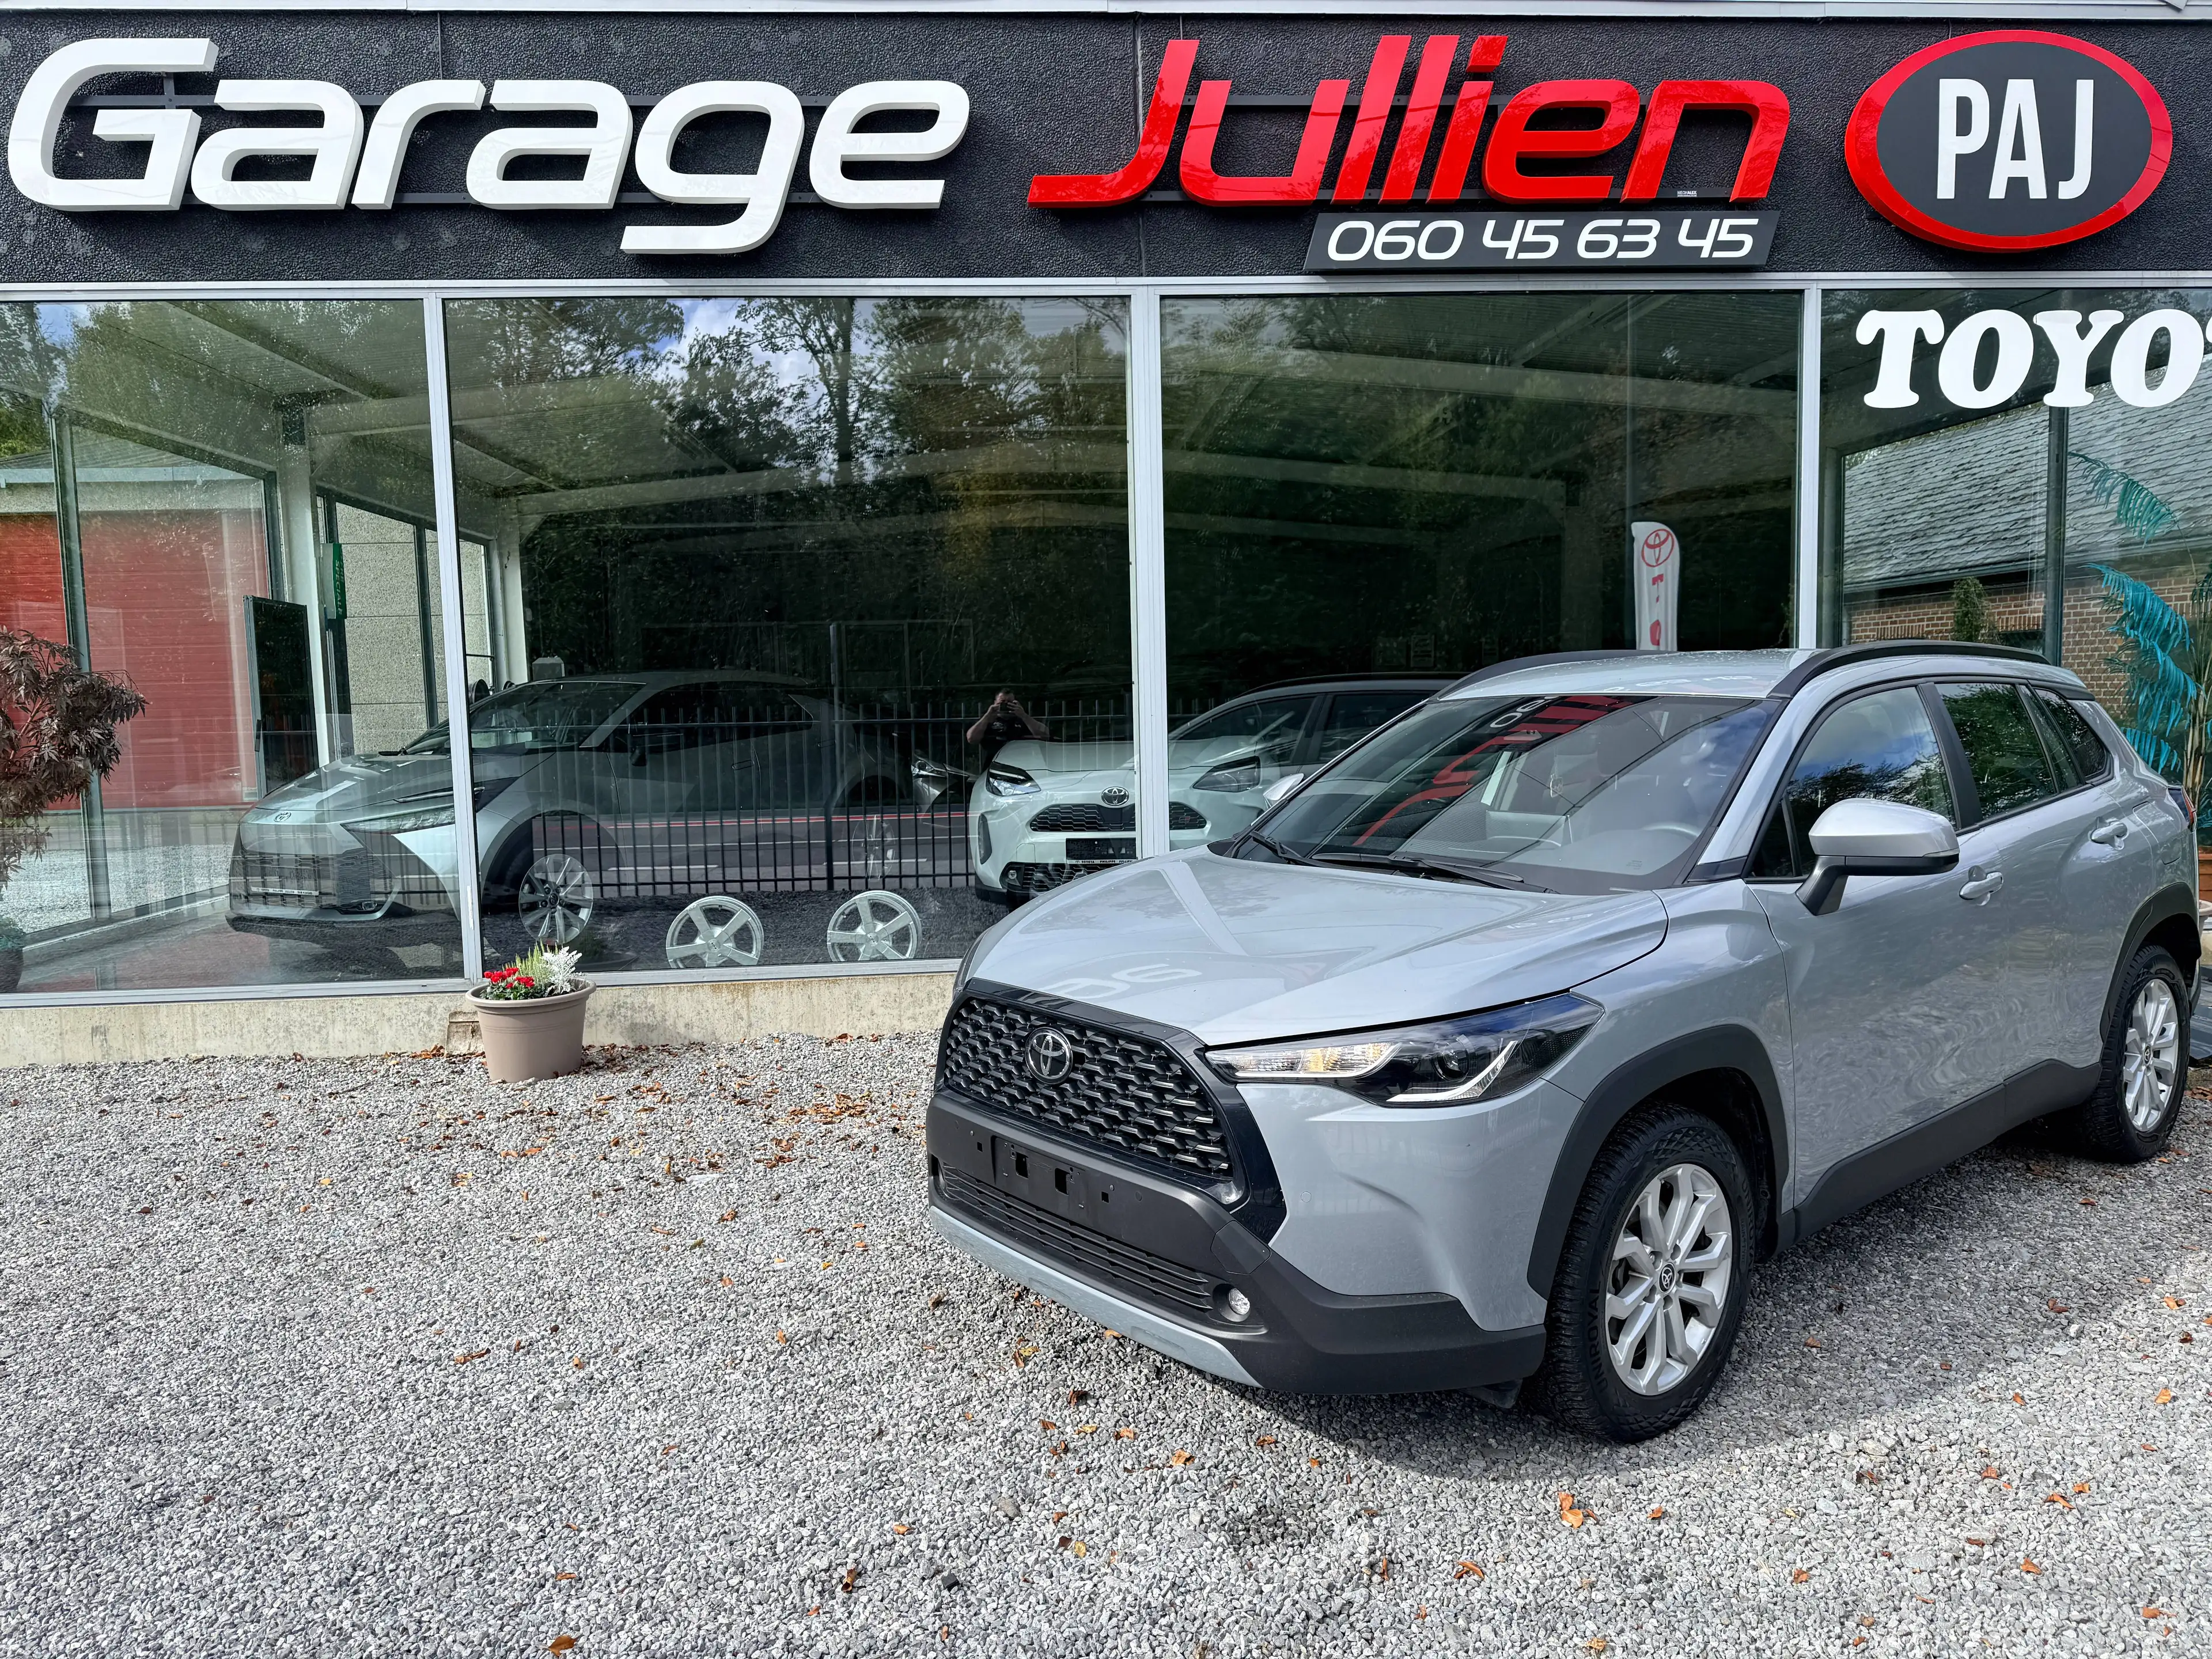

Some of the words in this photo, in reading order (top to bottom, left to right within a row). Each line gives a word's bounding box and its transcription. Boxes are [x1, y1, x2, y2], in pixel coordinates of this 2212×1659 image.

[7, 38, 970, 255] Garage
[1028, 35, 1790, 209] Jullien
[1937, 78, 2094, 199] PAJ
[1327, 219, 1464, 261] 060
[1482, 219, 1565, 259] 45
[1577, 219, 1660, 259] 63
[1677, 218, 1759, 258] 45
[1855, 309, 2212, 409] TOYO
[1588, 1280, 1608, 1393] UNIROYAL
